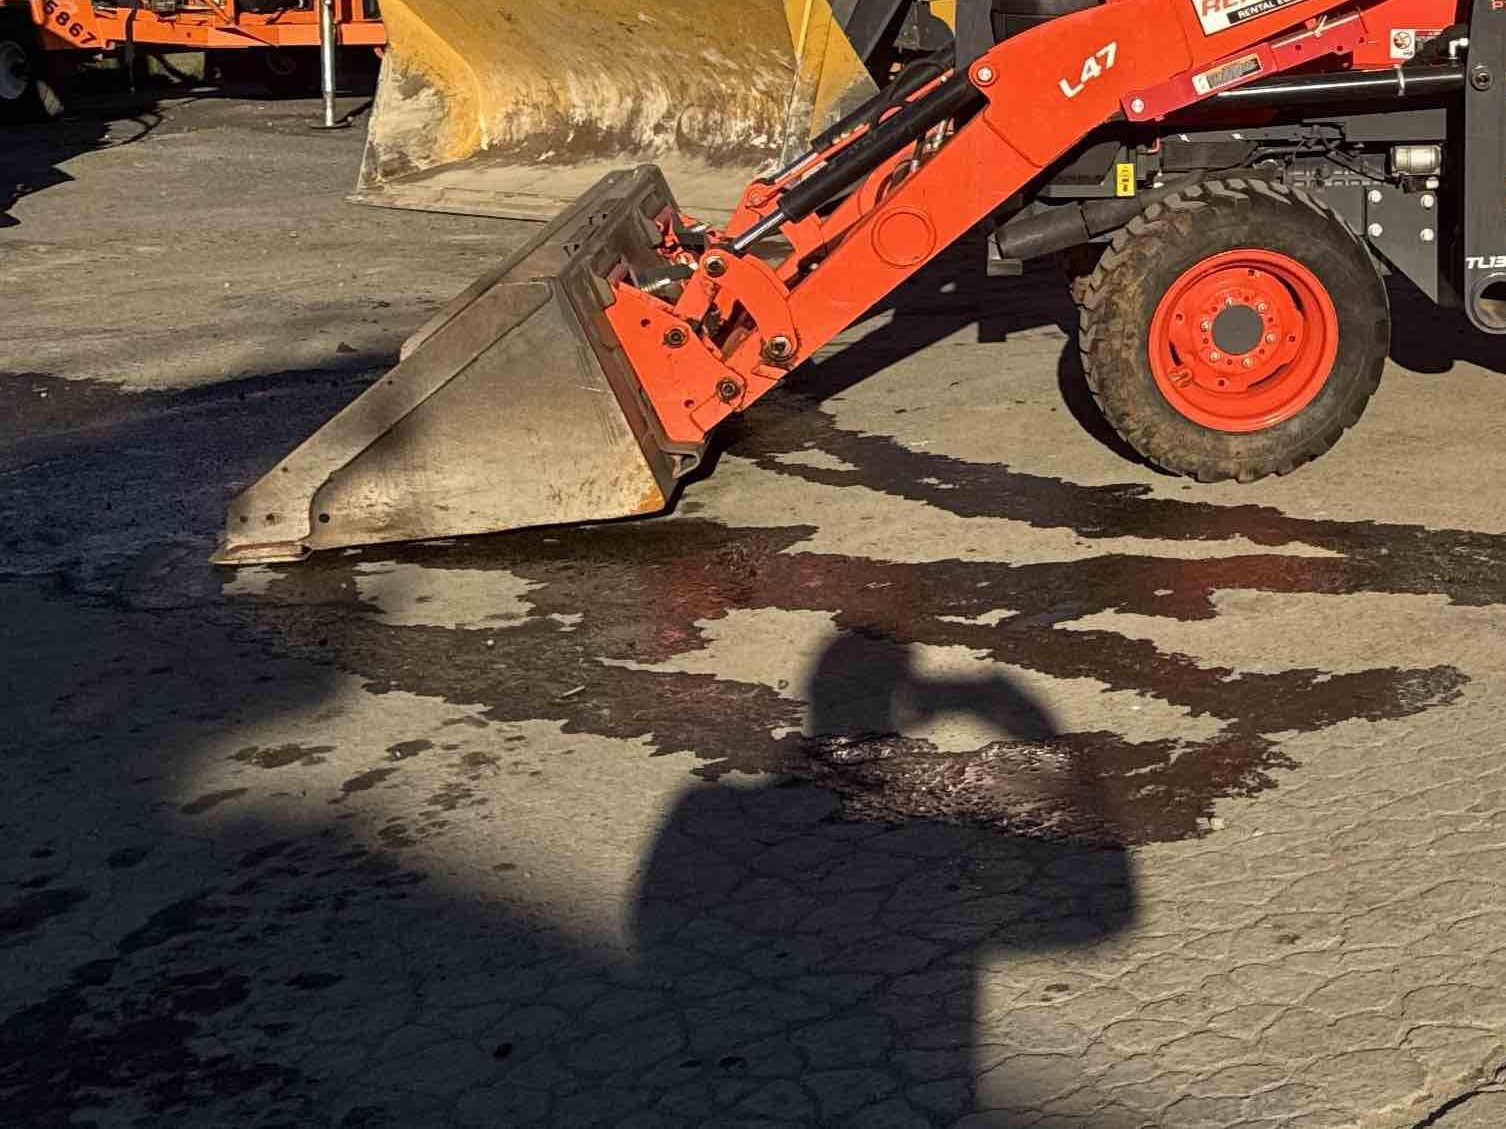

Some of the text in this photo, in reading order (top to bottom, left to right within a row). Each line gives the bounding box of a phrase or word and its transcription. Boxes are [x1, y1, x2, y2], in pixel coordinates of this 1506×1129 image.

[42, 0, 97, 45] 5867
[1237, 1, 1274, 19] RENTAL
[1059, 41, 1118, 99] L47
